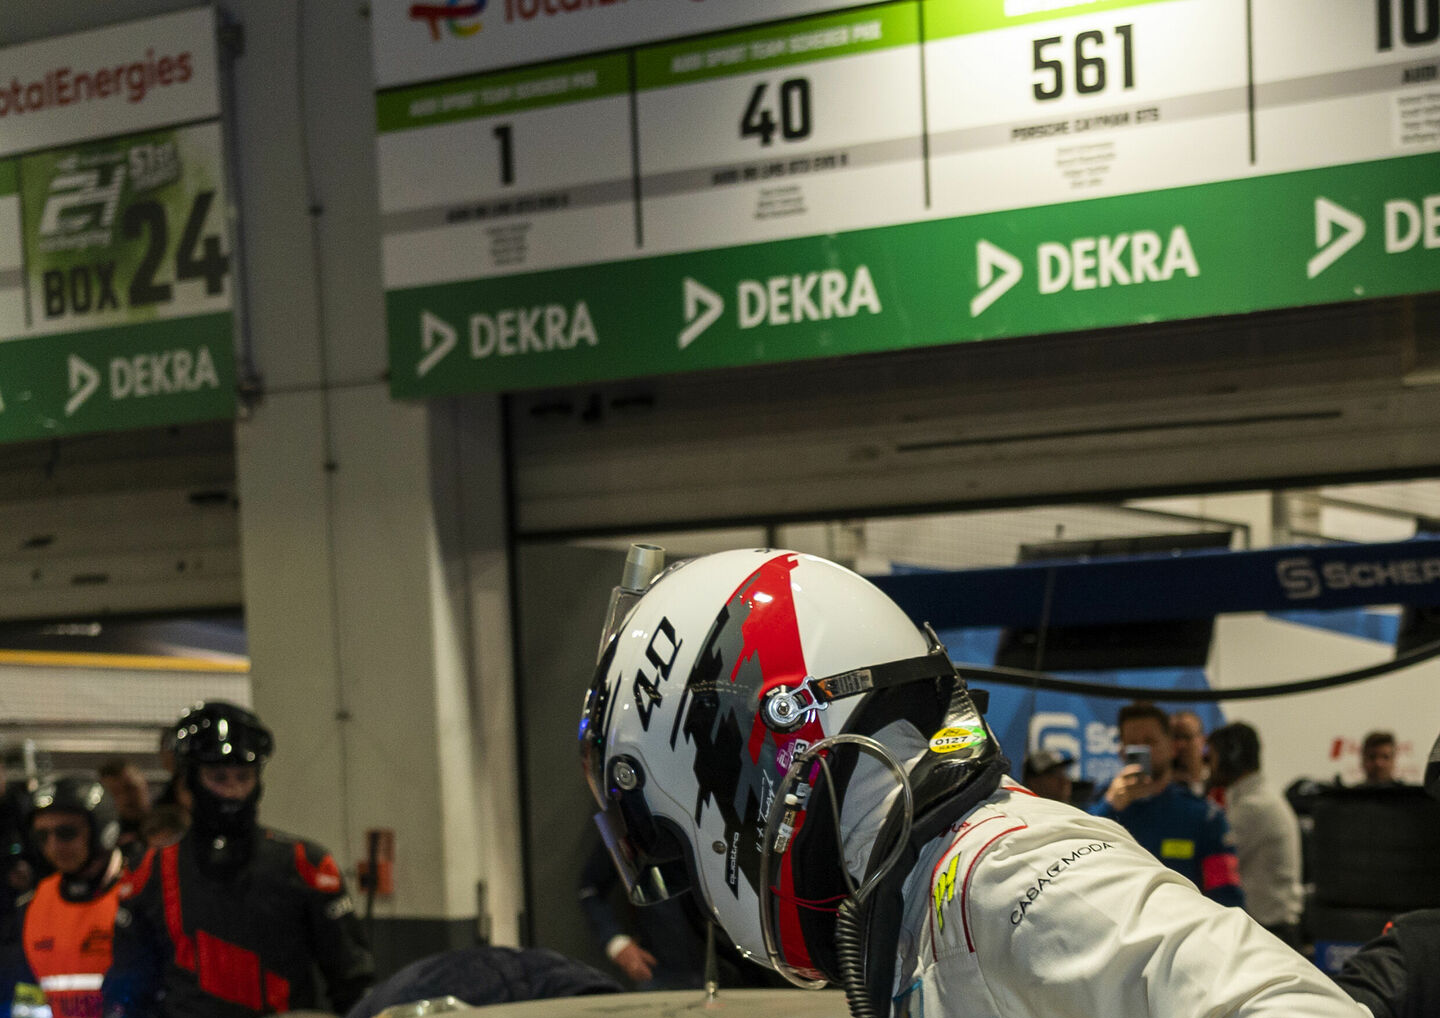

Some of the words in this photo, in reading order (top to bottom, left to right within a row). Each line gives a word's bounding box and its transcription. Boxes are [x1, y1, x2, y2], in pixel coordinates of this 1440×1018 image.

[0, 50, 192, 117] talEnergies
[1032, 24, 1134, 101] 561
[739, 78, 812, 146] 40
[492, 122, 515, 186] 1
[43, 259, 119, 319] BOX
[121, 191, 231, 306] 24
[1037, 225, 1201, 295] DEKRA
[469, 300, 599, 360] DEKRA
[737, 264, 882, 330] DEKRA
[109, 345, 220, 401] DEKRA
[633, 616, 682, 732] 40
[935, 736, 969, 746] 0127
[1010, 878, 1052, 925] CASA
[1061, 842, 1116, 866] MODA
